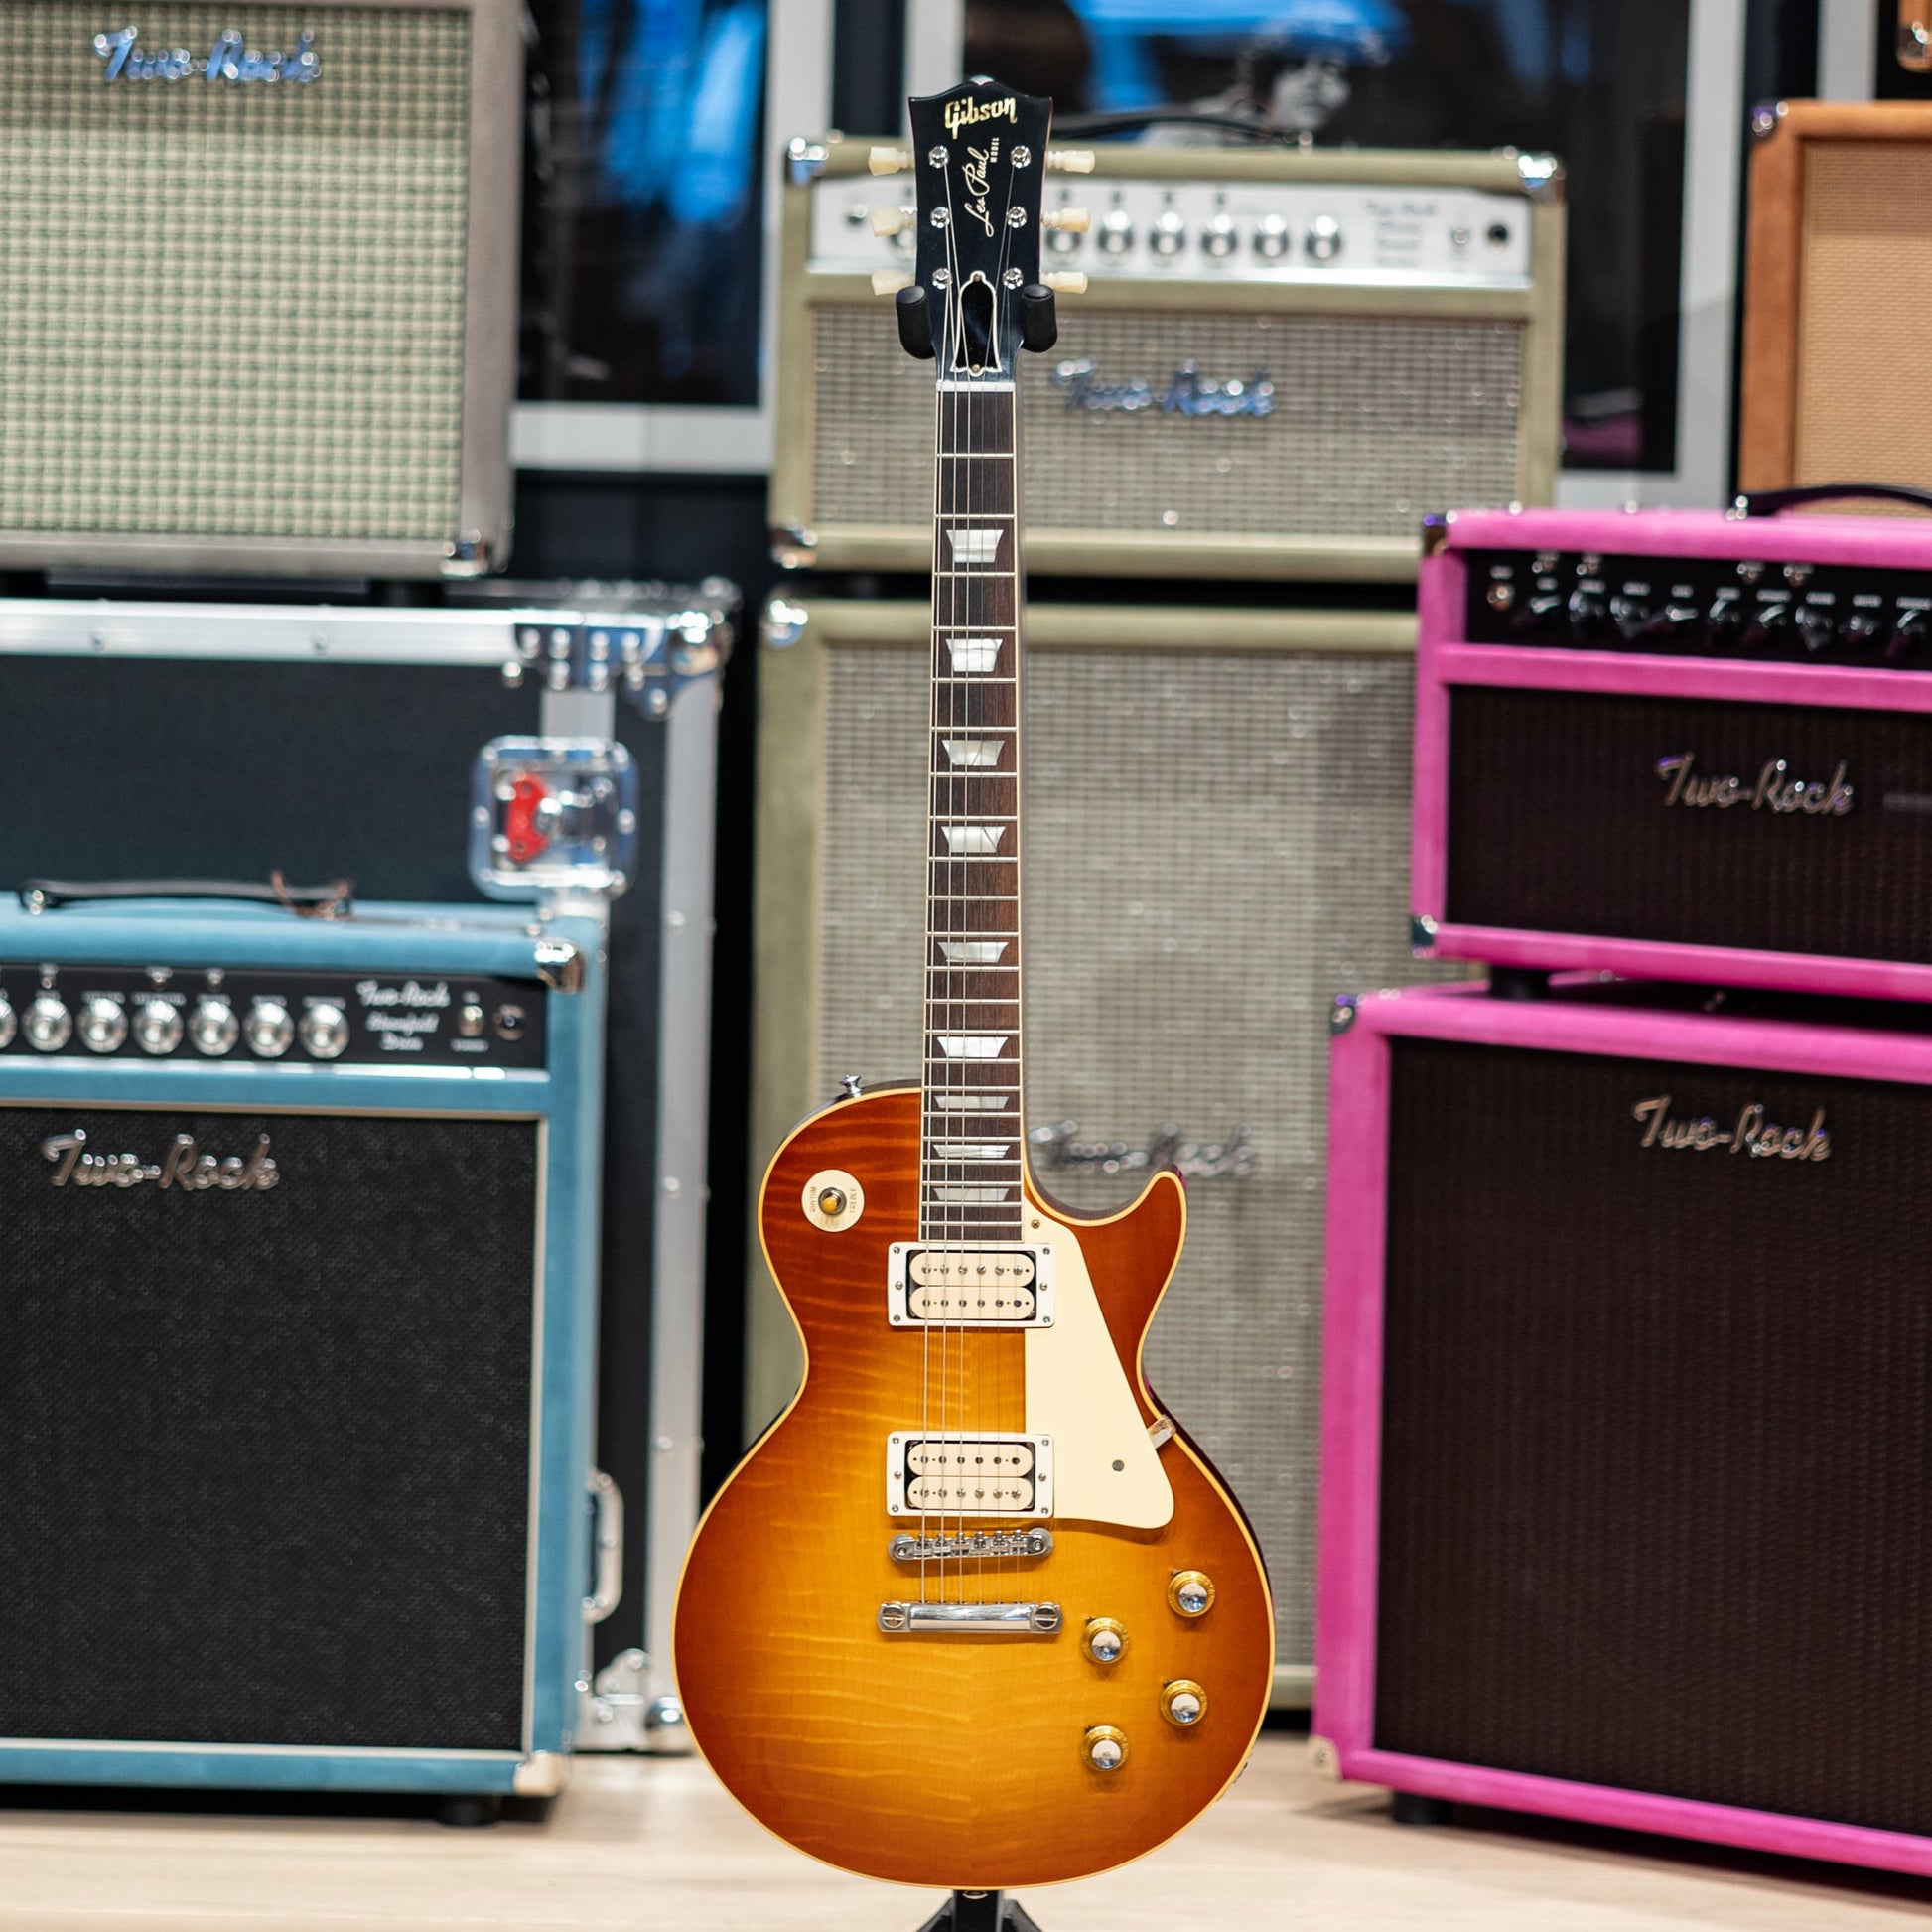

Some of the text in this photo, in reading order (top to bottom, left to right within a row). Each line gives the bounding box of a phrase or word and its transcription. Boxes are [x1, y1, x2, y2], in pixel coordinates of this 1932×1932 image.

[944, 96, 1018, 140] Gibson
[962, 146, 995, 238] Les Paul
[1656, 751, 1854, 816] Two-Rock
[42, 1128, 279, 1191] Two-Rock
[1633, 1095, 1833, 1162] Two-Rock
